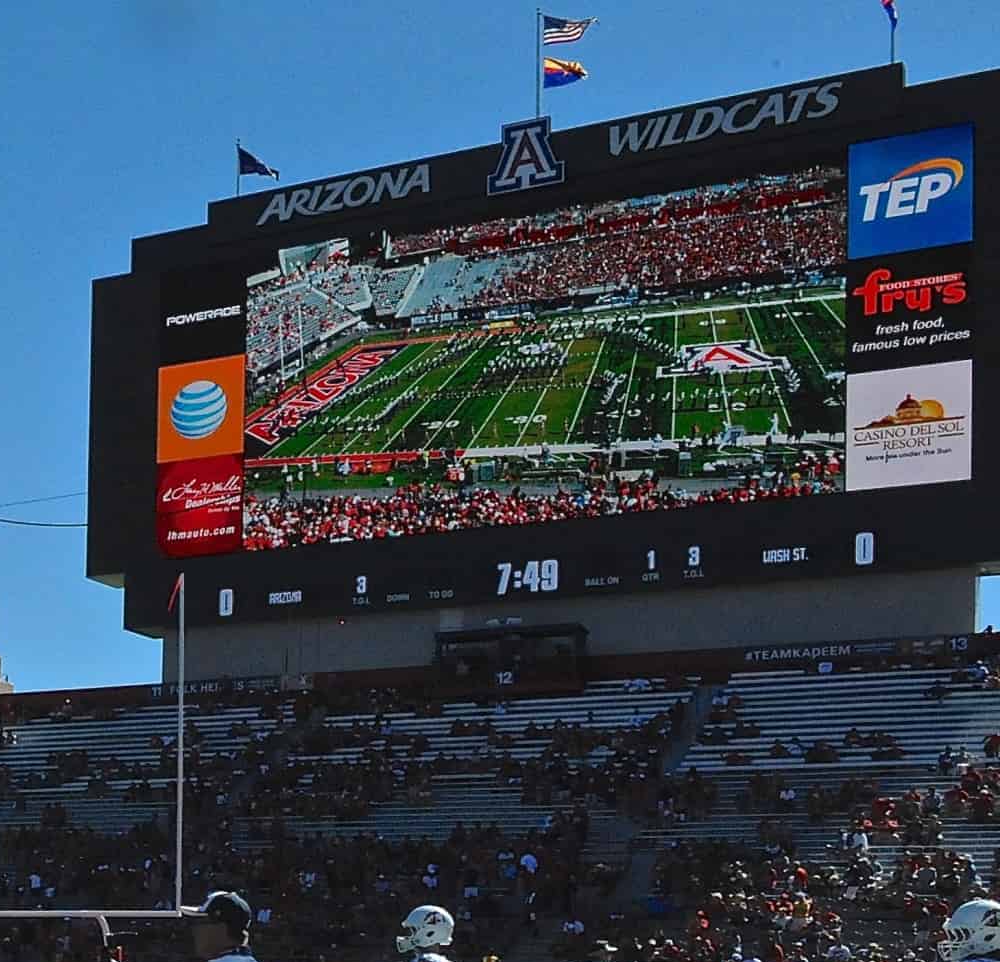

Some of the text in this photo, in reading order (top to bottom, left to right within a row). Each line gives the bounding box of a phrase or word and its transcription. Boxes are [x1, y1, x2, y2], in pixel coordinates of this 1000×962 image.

[609, 81, 842, 156] WILDCATS
[487, 115, 565, 196] A
[256, 163, 430, 226] ARIZONA
[859, 173, 953, 222] TEP
[166, 304, 241, 327] POWERADE
[875, 316, 946, 336] fresh food,
[852, 329, 972, 353] famous low prices
[853, 421, 964, 442] CASINO DEL SOL
[882, 437, 932, 451] RESORT
[168, 526, 236, 541] lhmauto.com
[688, 546, 701, 566] 3
[763, 547, 809, 563] WASH ST.
[856, 532, 874, 565] 0
[647, 550, 656, 570] 1
[356, 575, 367, 594] 3
[497, 559, 559, 596] 7:49
[219, 588, 233, 616] 0
[745, 644, 851, 662] #TEAMKADEEM
[950, 637, 968, 651] 13
[497, 671, 513, 684] 12
